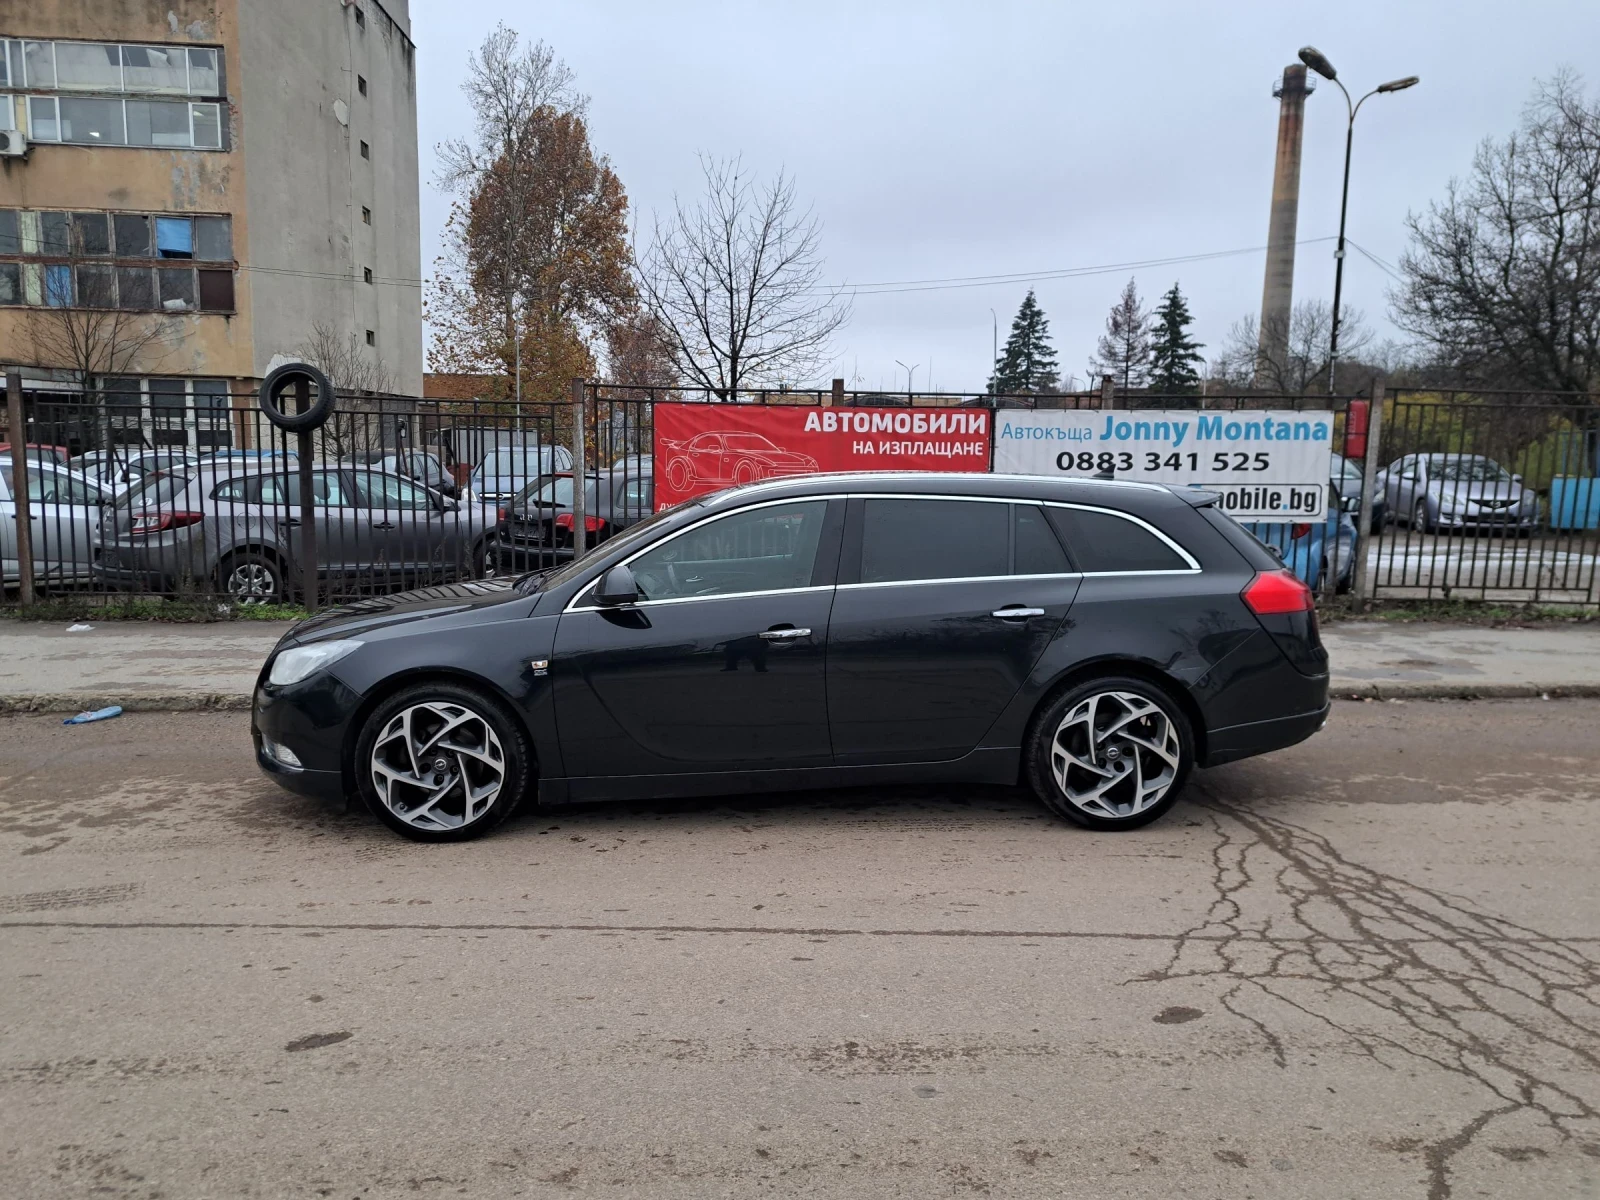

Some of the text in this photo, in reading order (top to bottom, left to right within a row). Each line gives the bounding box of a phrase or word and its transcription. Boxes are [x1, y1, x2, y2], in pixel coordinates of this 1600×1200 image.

[804, 411, 986, 435] АВТОМОБИЛИ
[1001, 422, 1093, 441] Автокъща
[1100, 415, 1189, 447] Jonny
[1197, 415, 1328, 441] Montana
[853, 441, 984, 458] НА ИЗПЛАЩАНЕ
[1056, 451, 1270, 471] 0883 341 525
